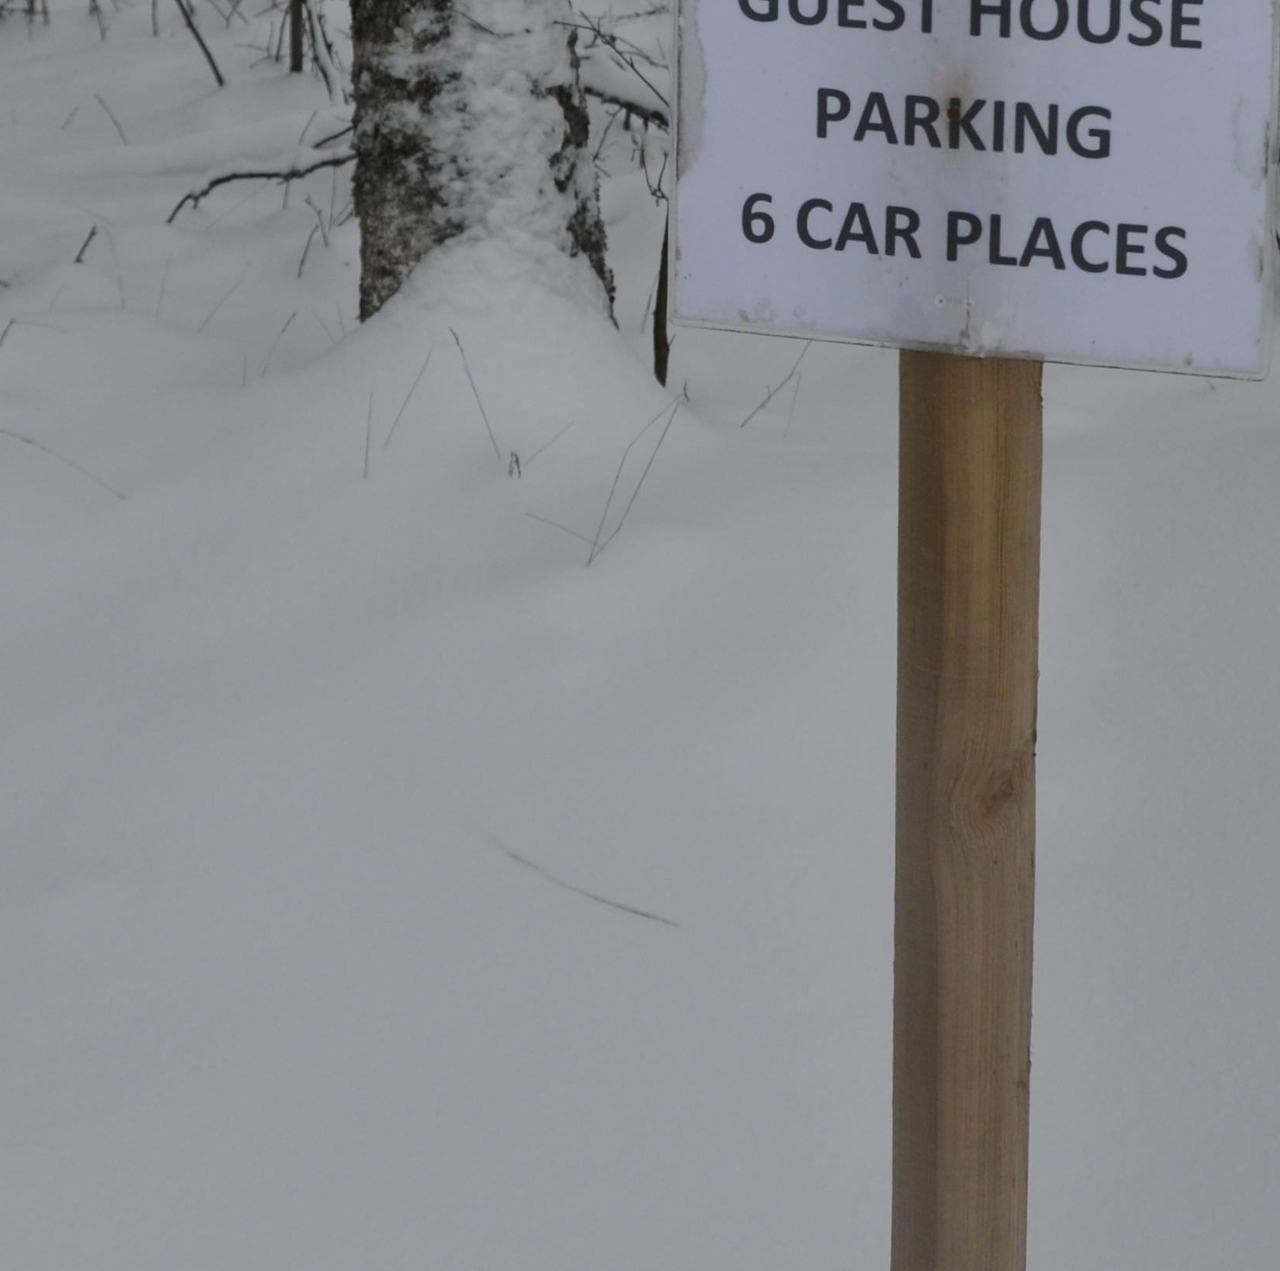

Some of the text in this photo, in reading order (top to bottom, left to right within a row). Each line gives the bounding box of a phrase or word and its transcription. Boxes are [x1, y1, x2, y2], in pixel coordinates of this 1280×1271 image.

[816, 87, 1112, 160] PARKING
[741, 192, 1188, 280] 6 CAR PLACES
